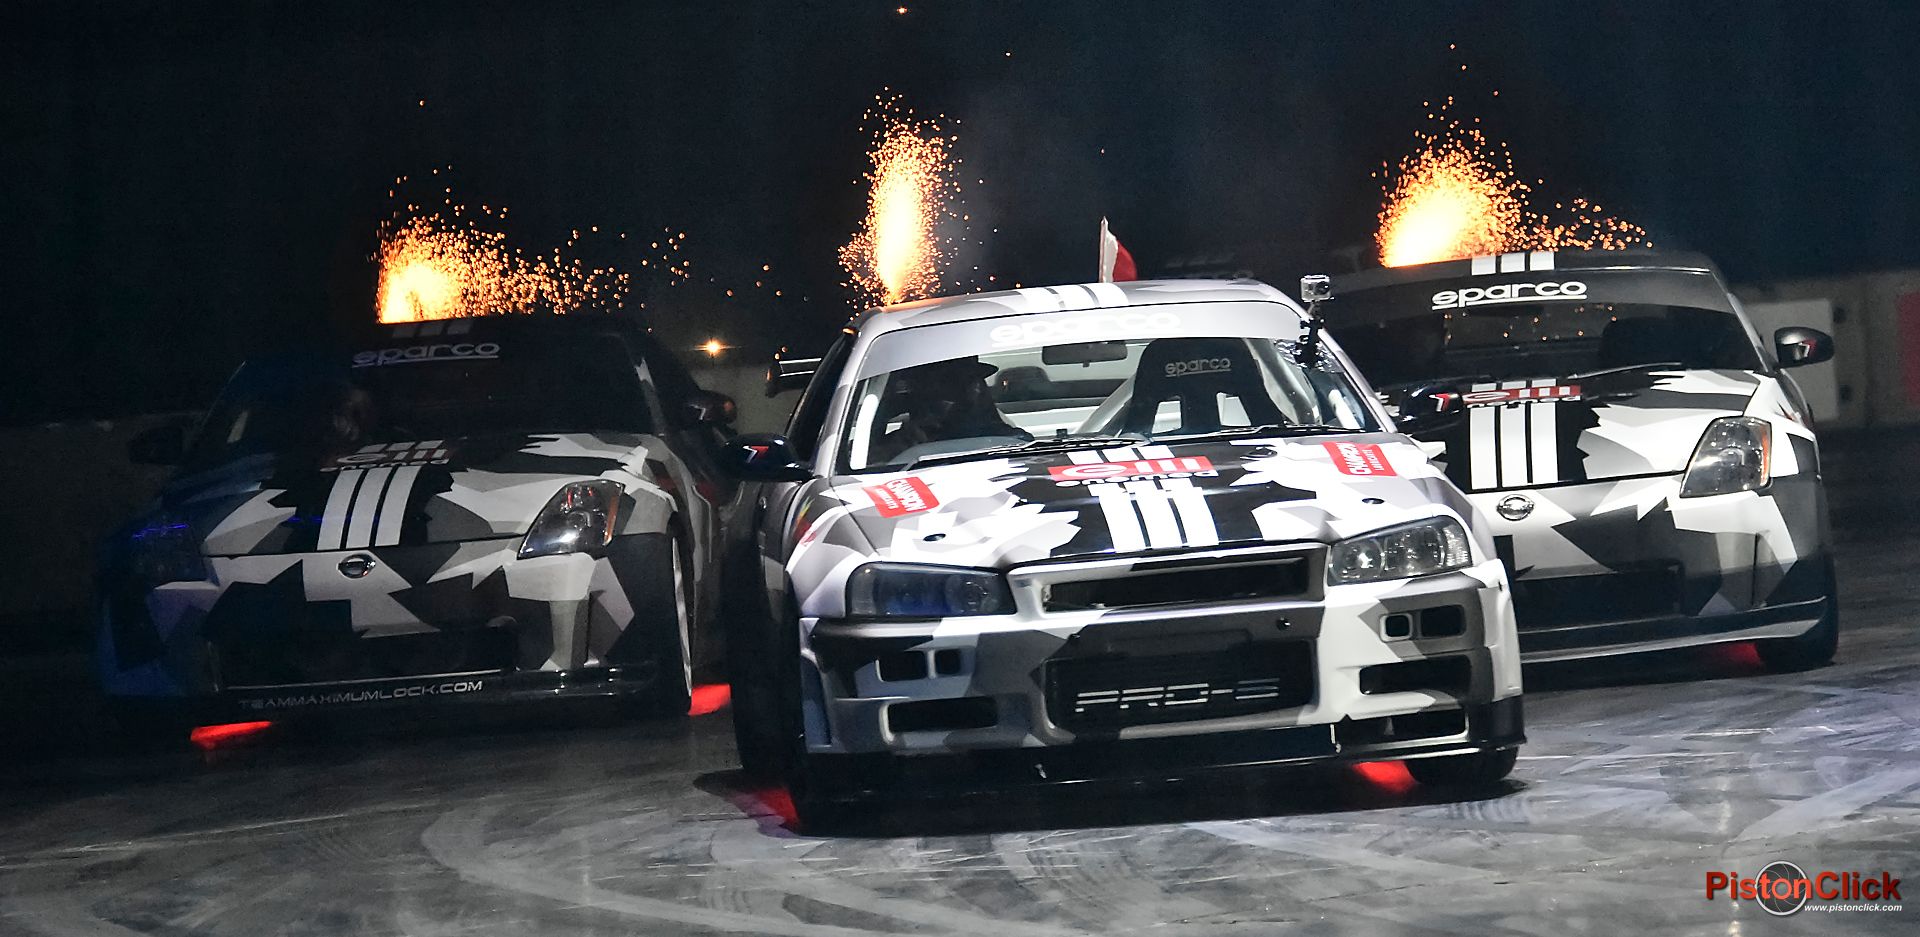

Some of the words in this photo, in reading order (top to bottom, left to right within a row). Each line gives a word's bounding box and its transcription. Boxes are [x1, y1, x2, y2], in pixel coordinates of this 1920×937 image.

[1432, 281, 1588, 310] sparco
[989, 312, 1182, 347] sparco
[352, 342, 501, 368] sparco
[1165, 357, 1231, 376] sparco
[238, 680, 483, 710] TEAMMAXIMUMLOCK.COM
